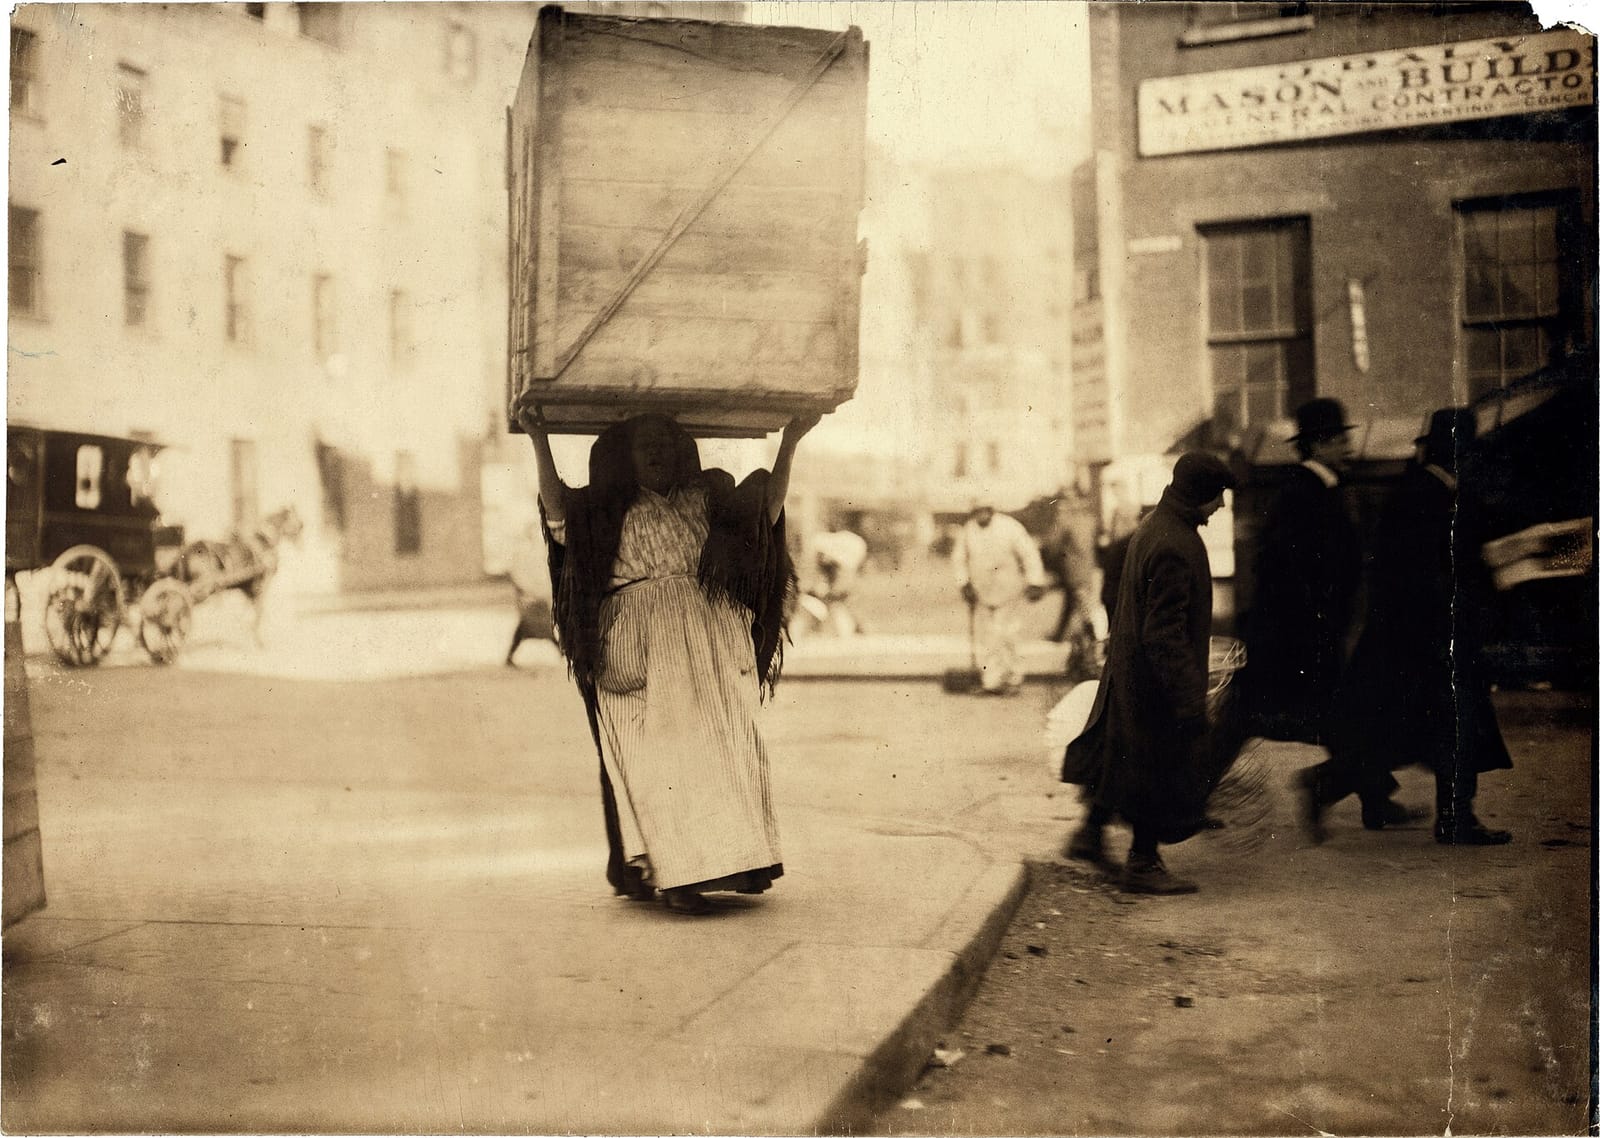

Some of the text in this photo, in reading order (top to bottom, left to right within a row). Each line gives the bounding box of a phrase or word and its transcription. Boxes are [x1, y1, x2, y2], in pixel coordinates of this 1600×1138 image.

[1156, 77, 1344, 115] MASON
[1399, 45, 1593, 90] BUILD
[1371, 72, 1593, 111] CONTRACTO
